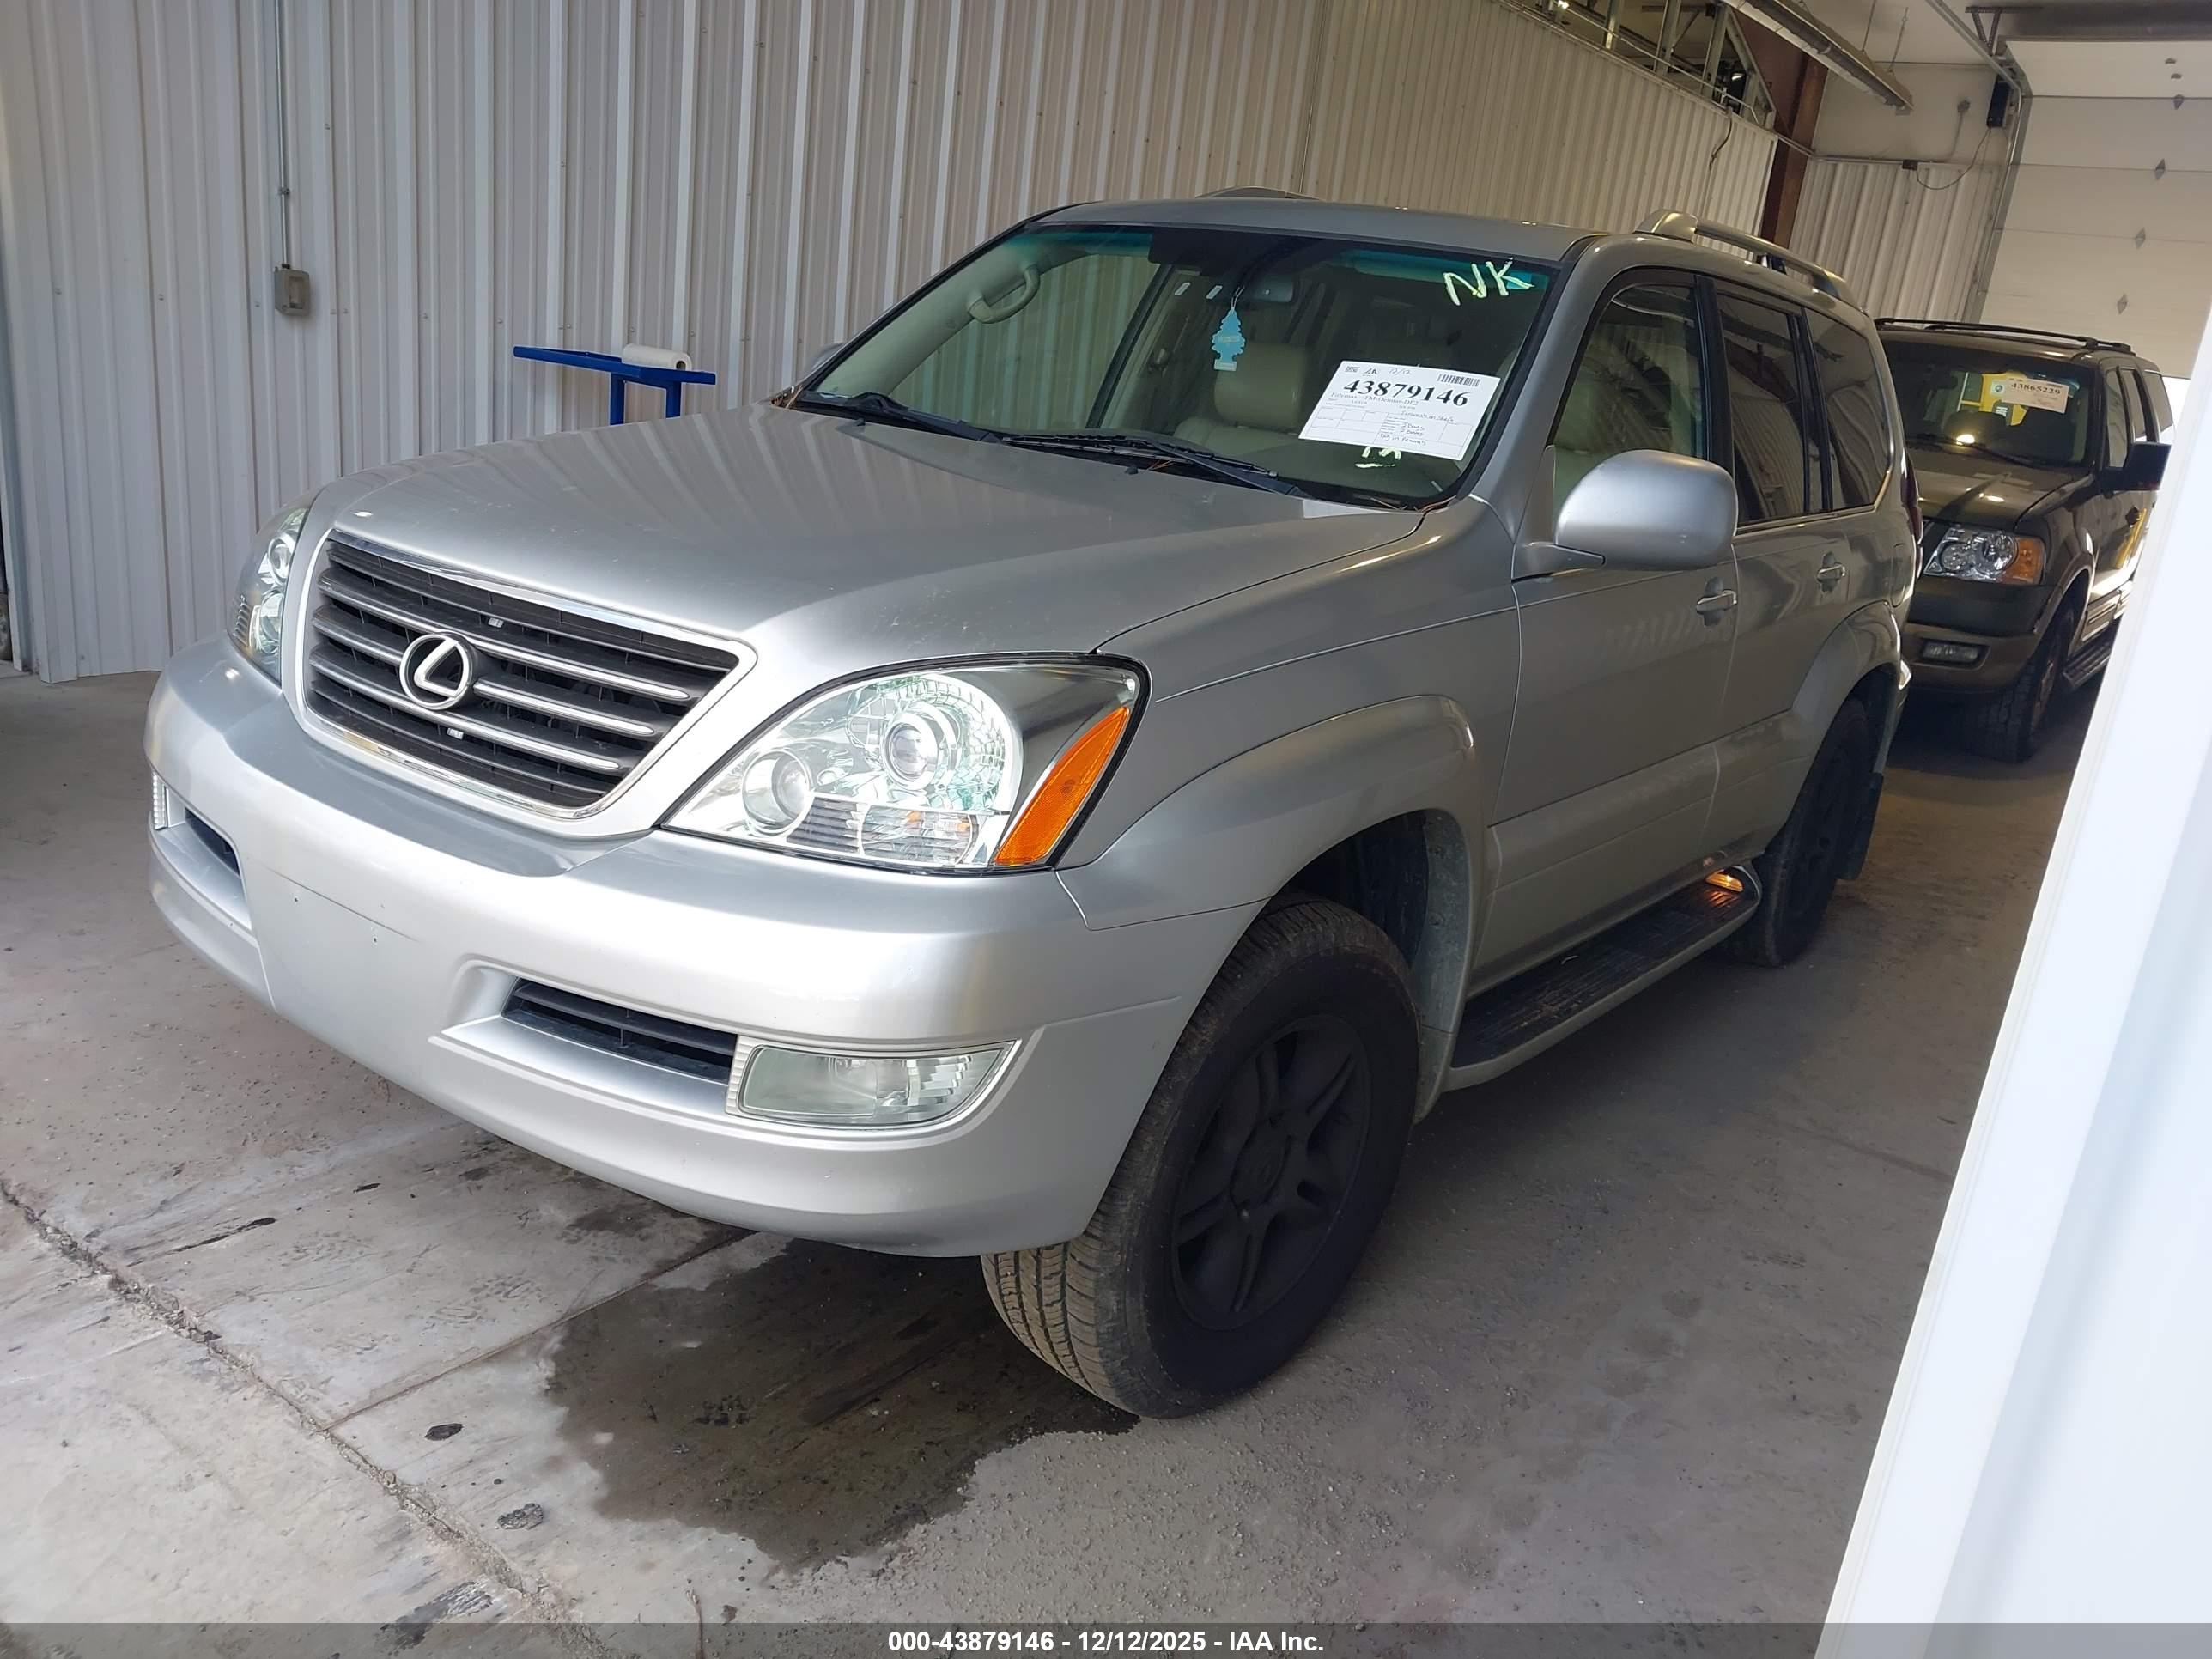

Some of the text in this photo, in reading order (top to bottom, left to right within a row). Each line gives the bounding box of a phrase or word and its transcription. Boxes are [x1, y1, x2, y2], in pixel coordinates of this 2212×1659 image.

[1443, 258, 1534, 306] NK
[1343, 379, 1471, 407] 43879146
[2011, 382, 2061, 395] 43865229
